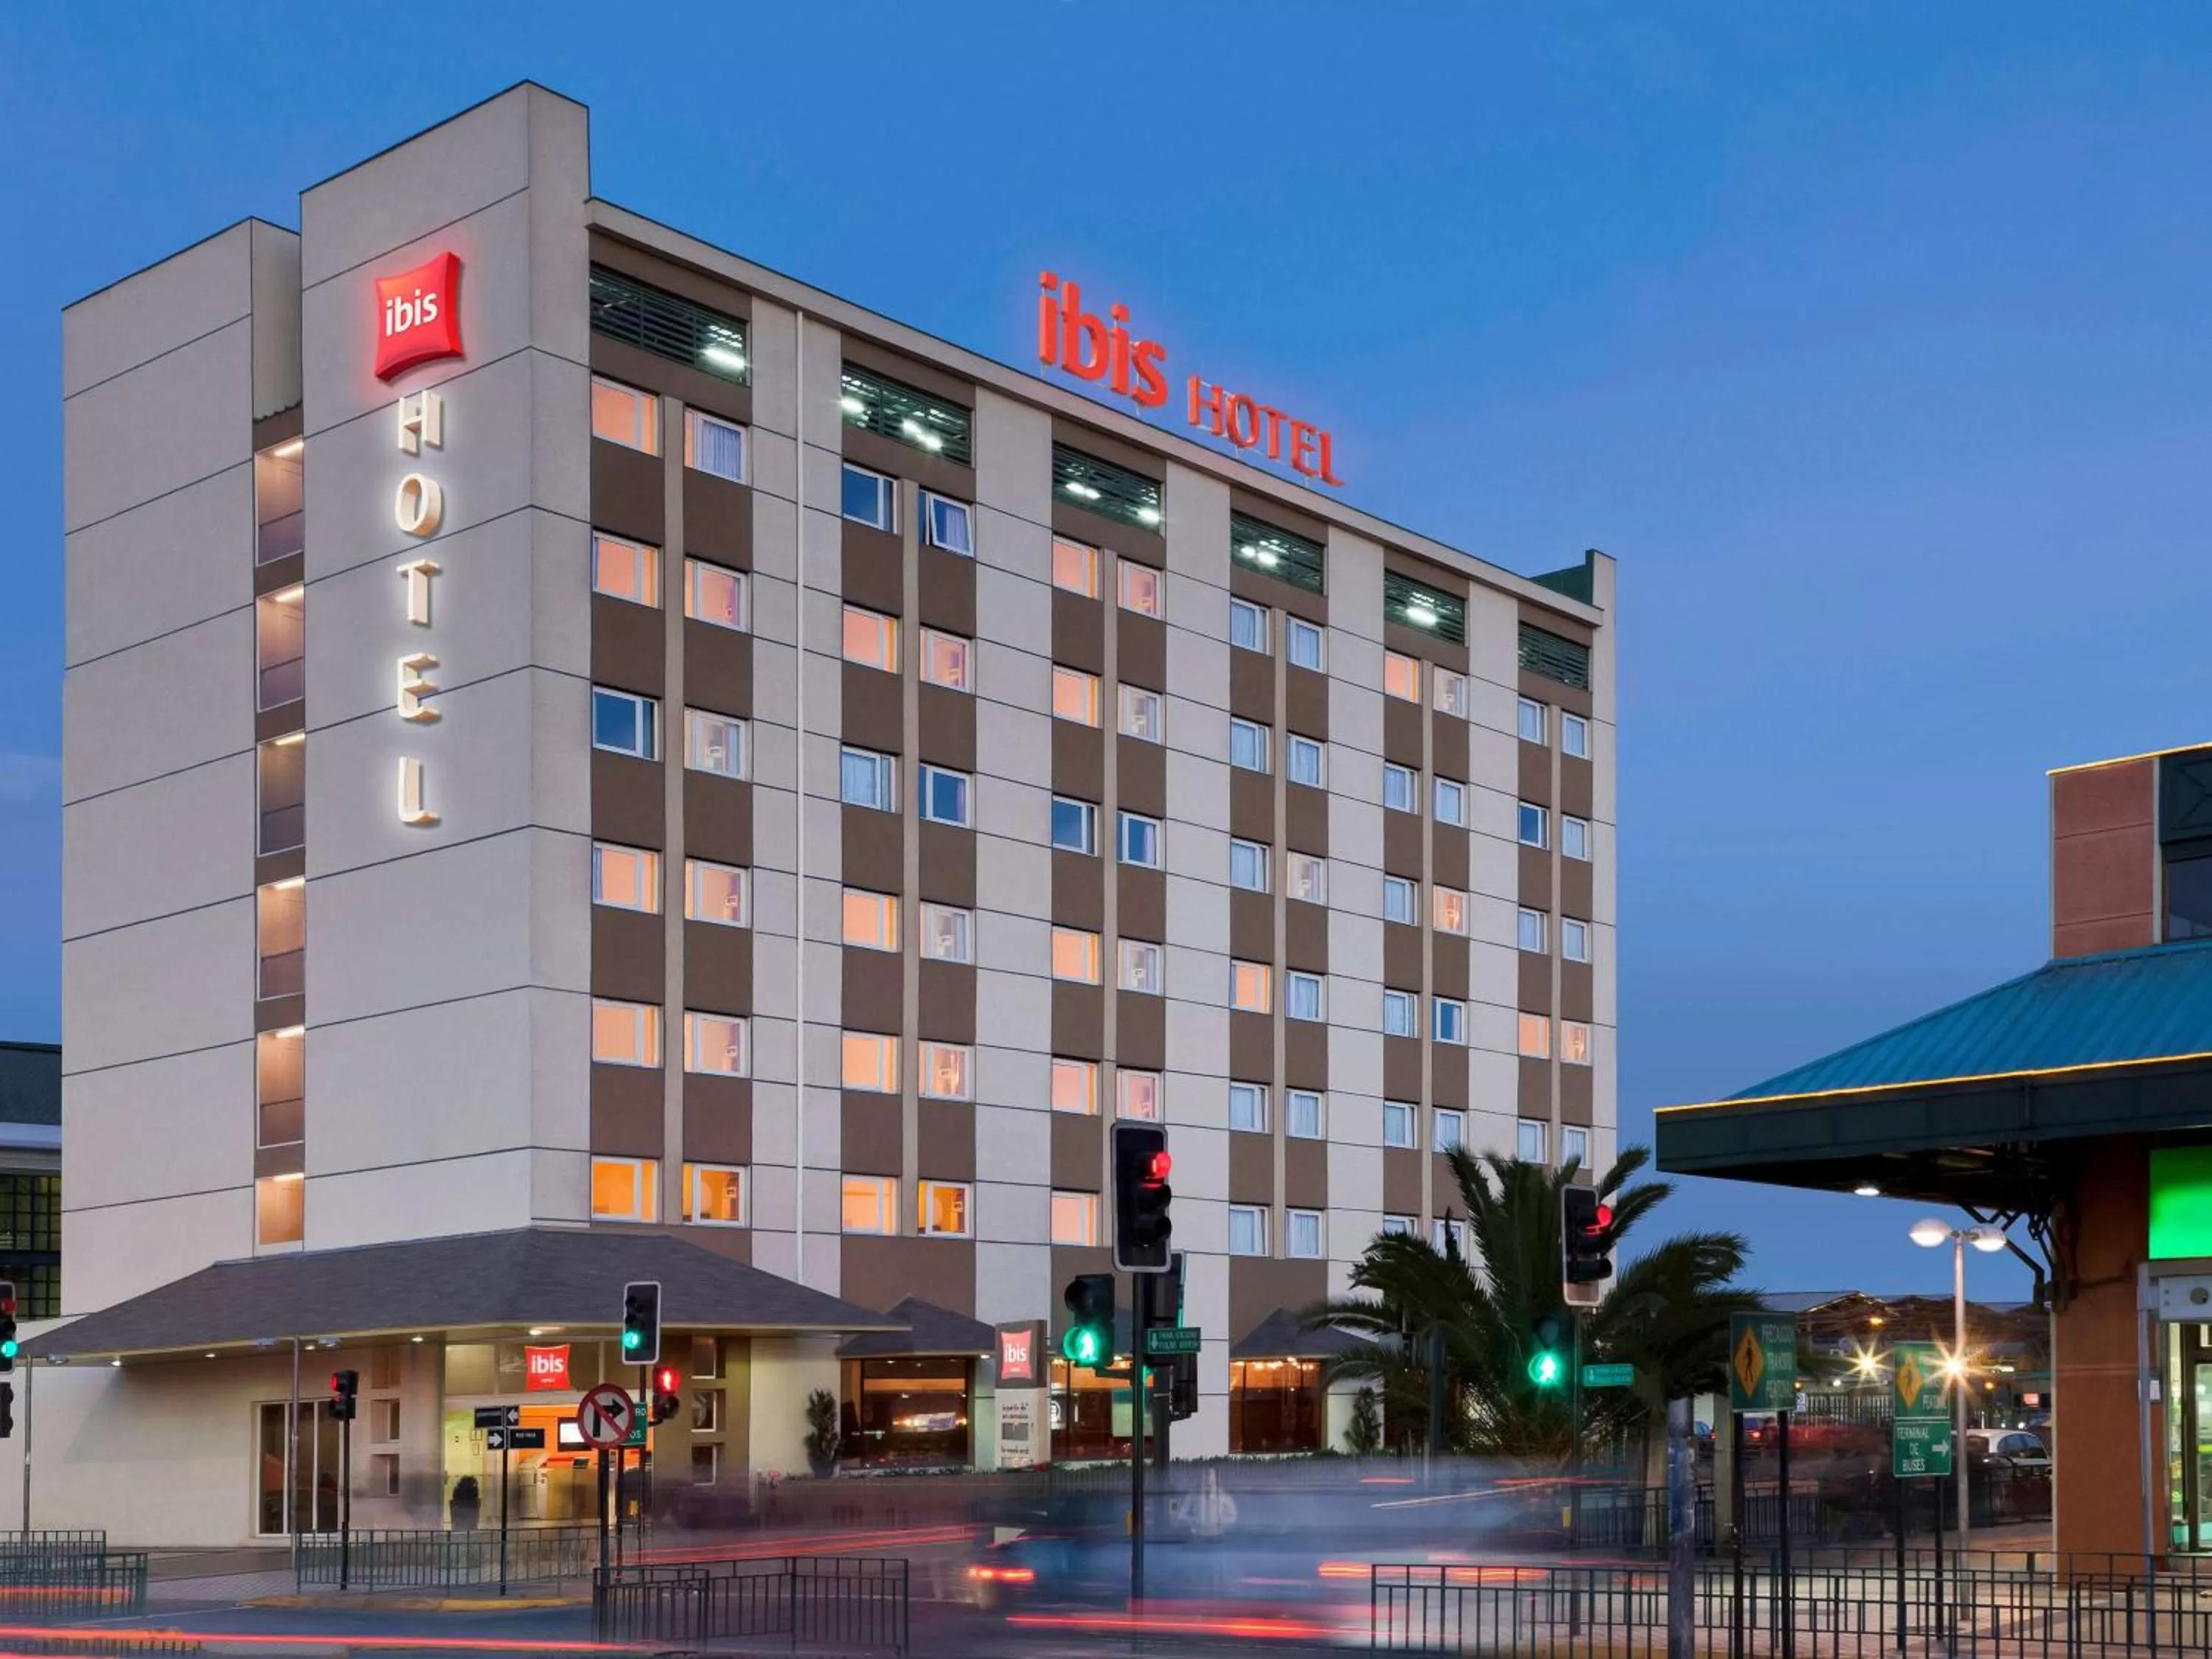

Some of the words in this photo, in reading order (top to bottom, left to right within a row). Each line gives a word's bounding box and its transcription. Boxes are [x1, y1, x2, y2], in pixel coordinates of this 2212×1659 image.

[384, 288, 439, 338] ibis
[1039, 271, 1169, 408] ibis
[1187, 375, 1346, 487] HOTEL
[395, 390, 442, 828] HOTEL
[531, 1353, 564, 1374] ibis
[1004, 1342, 1027, 1364] ibis
[1896, 1427, 1930, 1440] TERMINAL
[1909, 1442, 1919, 1455] DE
[1902, 1458, 1926, 1472] BUSES
